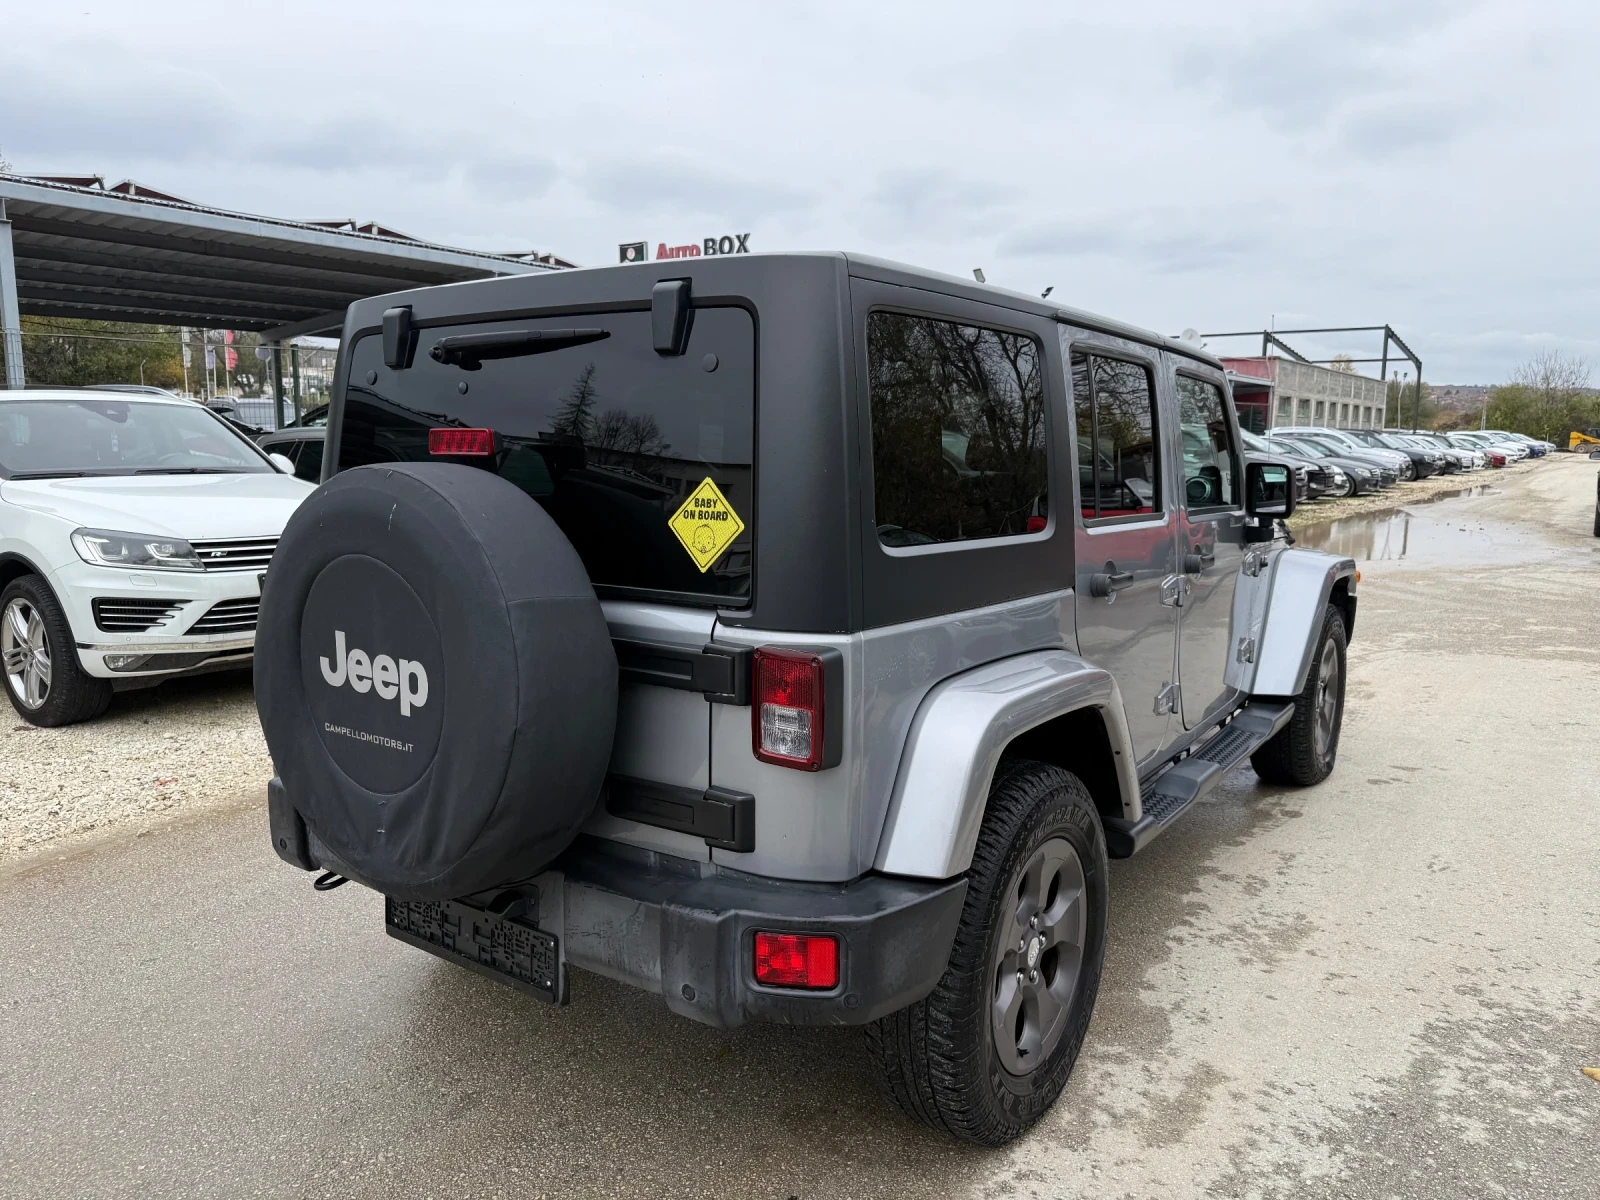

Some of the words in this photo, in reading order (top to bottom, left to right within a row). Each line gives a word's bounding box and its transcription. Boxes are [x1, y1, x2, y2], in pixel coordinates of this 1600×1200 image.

[703, 233, 751, 256] BOX
[694, 498, 718, 508] BABY
[683, 510, 695, 519] ON
[698, 510, 728, 521] BOARD
[320, 630, 428, 717] Jeep
[324, 722, 414, 752] CAMPELLOMOTORS.IT
